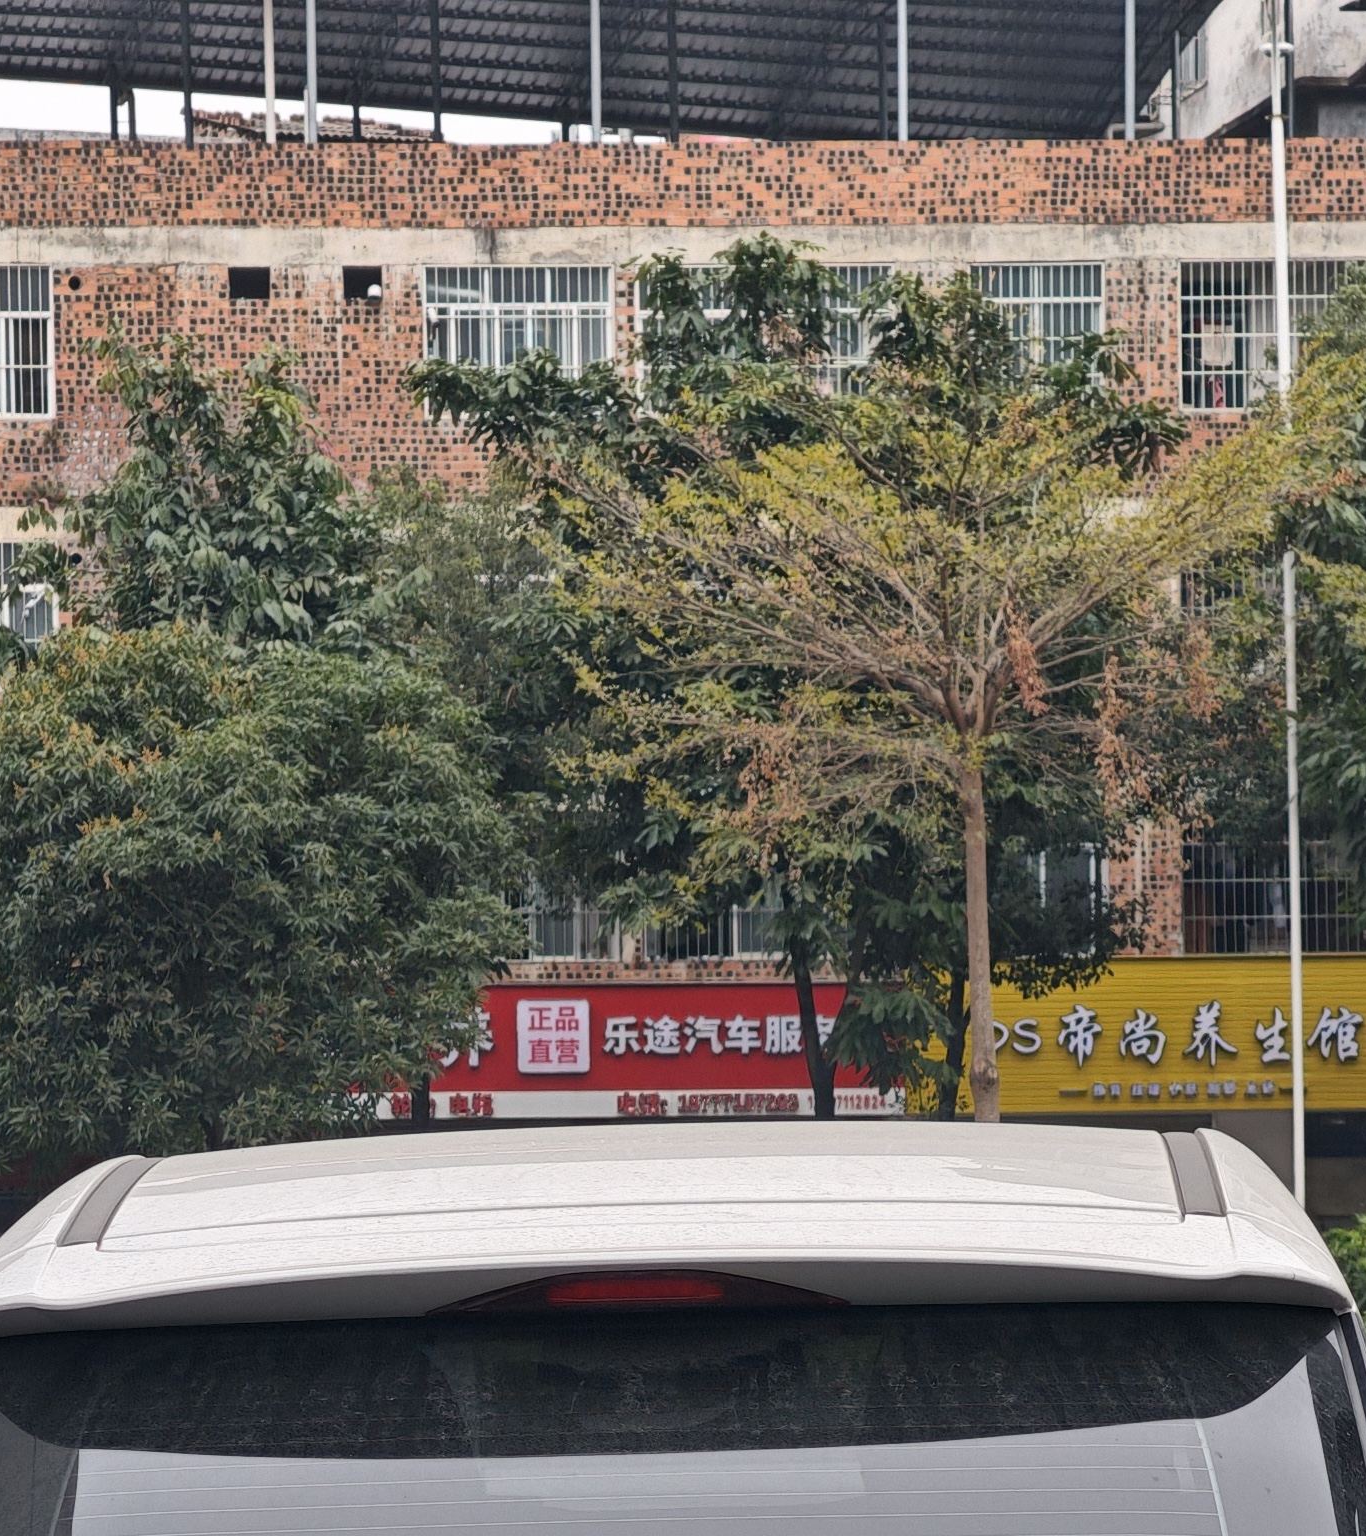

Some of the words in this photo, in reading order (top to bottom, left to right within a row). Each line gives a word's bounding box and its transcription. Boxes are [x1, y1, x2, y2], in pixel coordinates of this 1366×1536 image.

[528, 1006, 580, 1032] 正品
[1057, 1000, 1365, 1067] 帝尚养生馆
[528, 1038, 580, 1064] 直营
